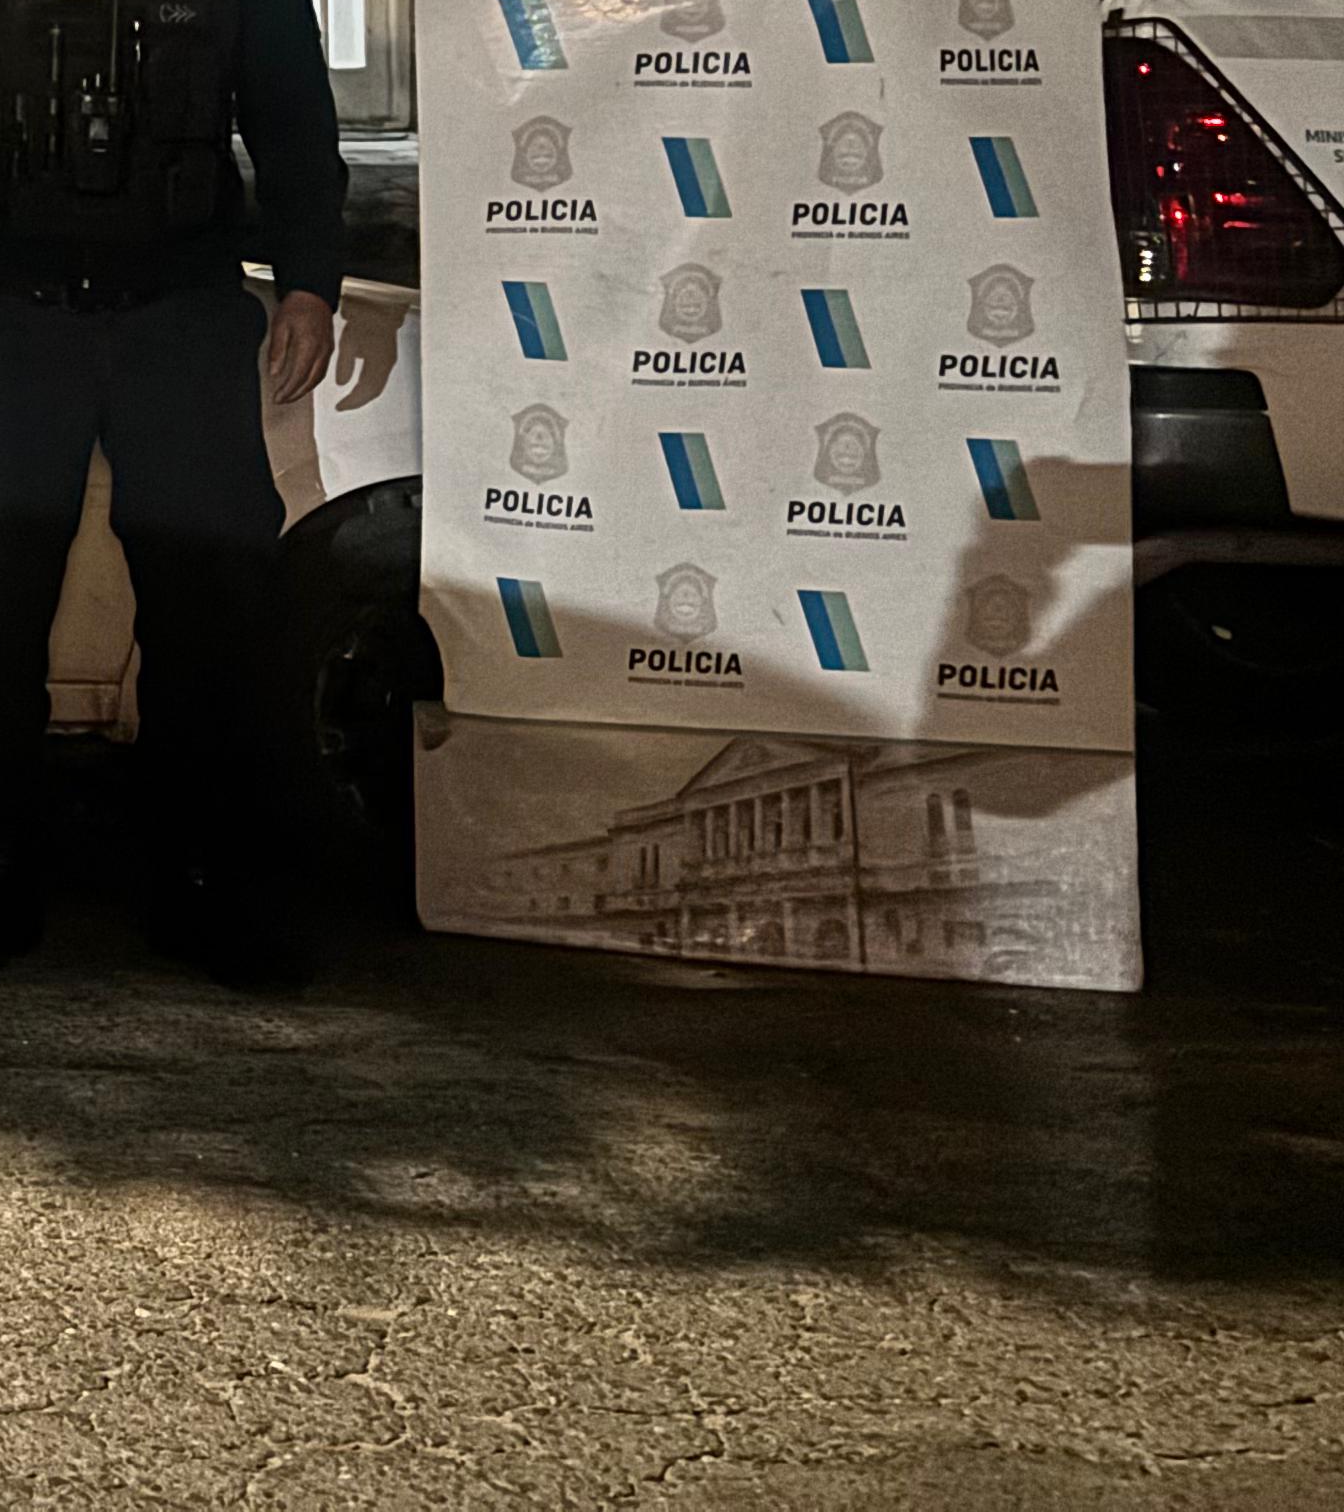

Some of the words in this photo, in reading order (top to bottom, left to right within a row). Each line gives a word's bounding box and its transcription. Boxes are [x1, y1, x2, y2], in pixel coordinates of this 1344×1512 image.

[634, 52, 751, 75] POLICIA
[939, 49, 1040, 73] POLICIA
[486, 199, 598, 222] POLICIA
[792, 202, 909, 226] POLICIA
[633, 350, 747, 374] POLICIA
[938, 354, 1060, 379] POLICIA
[484, 488, 593, 519] POLICIA
[787, 500, 906, 528] POLICIA
[628, 648, 742, 675] POLICIA
[938, 663, 1059, 692] POLICIA
